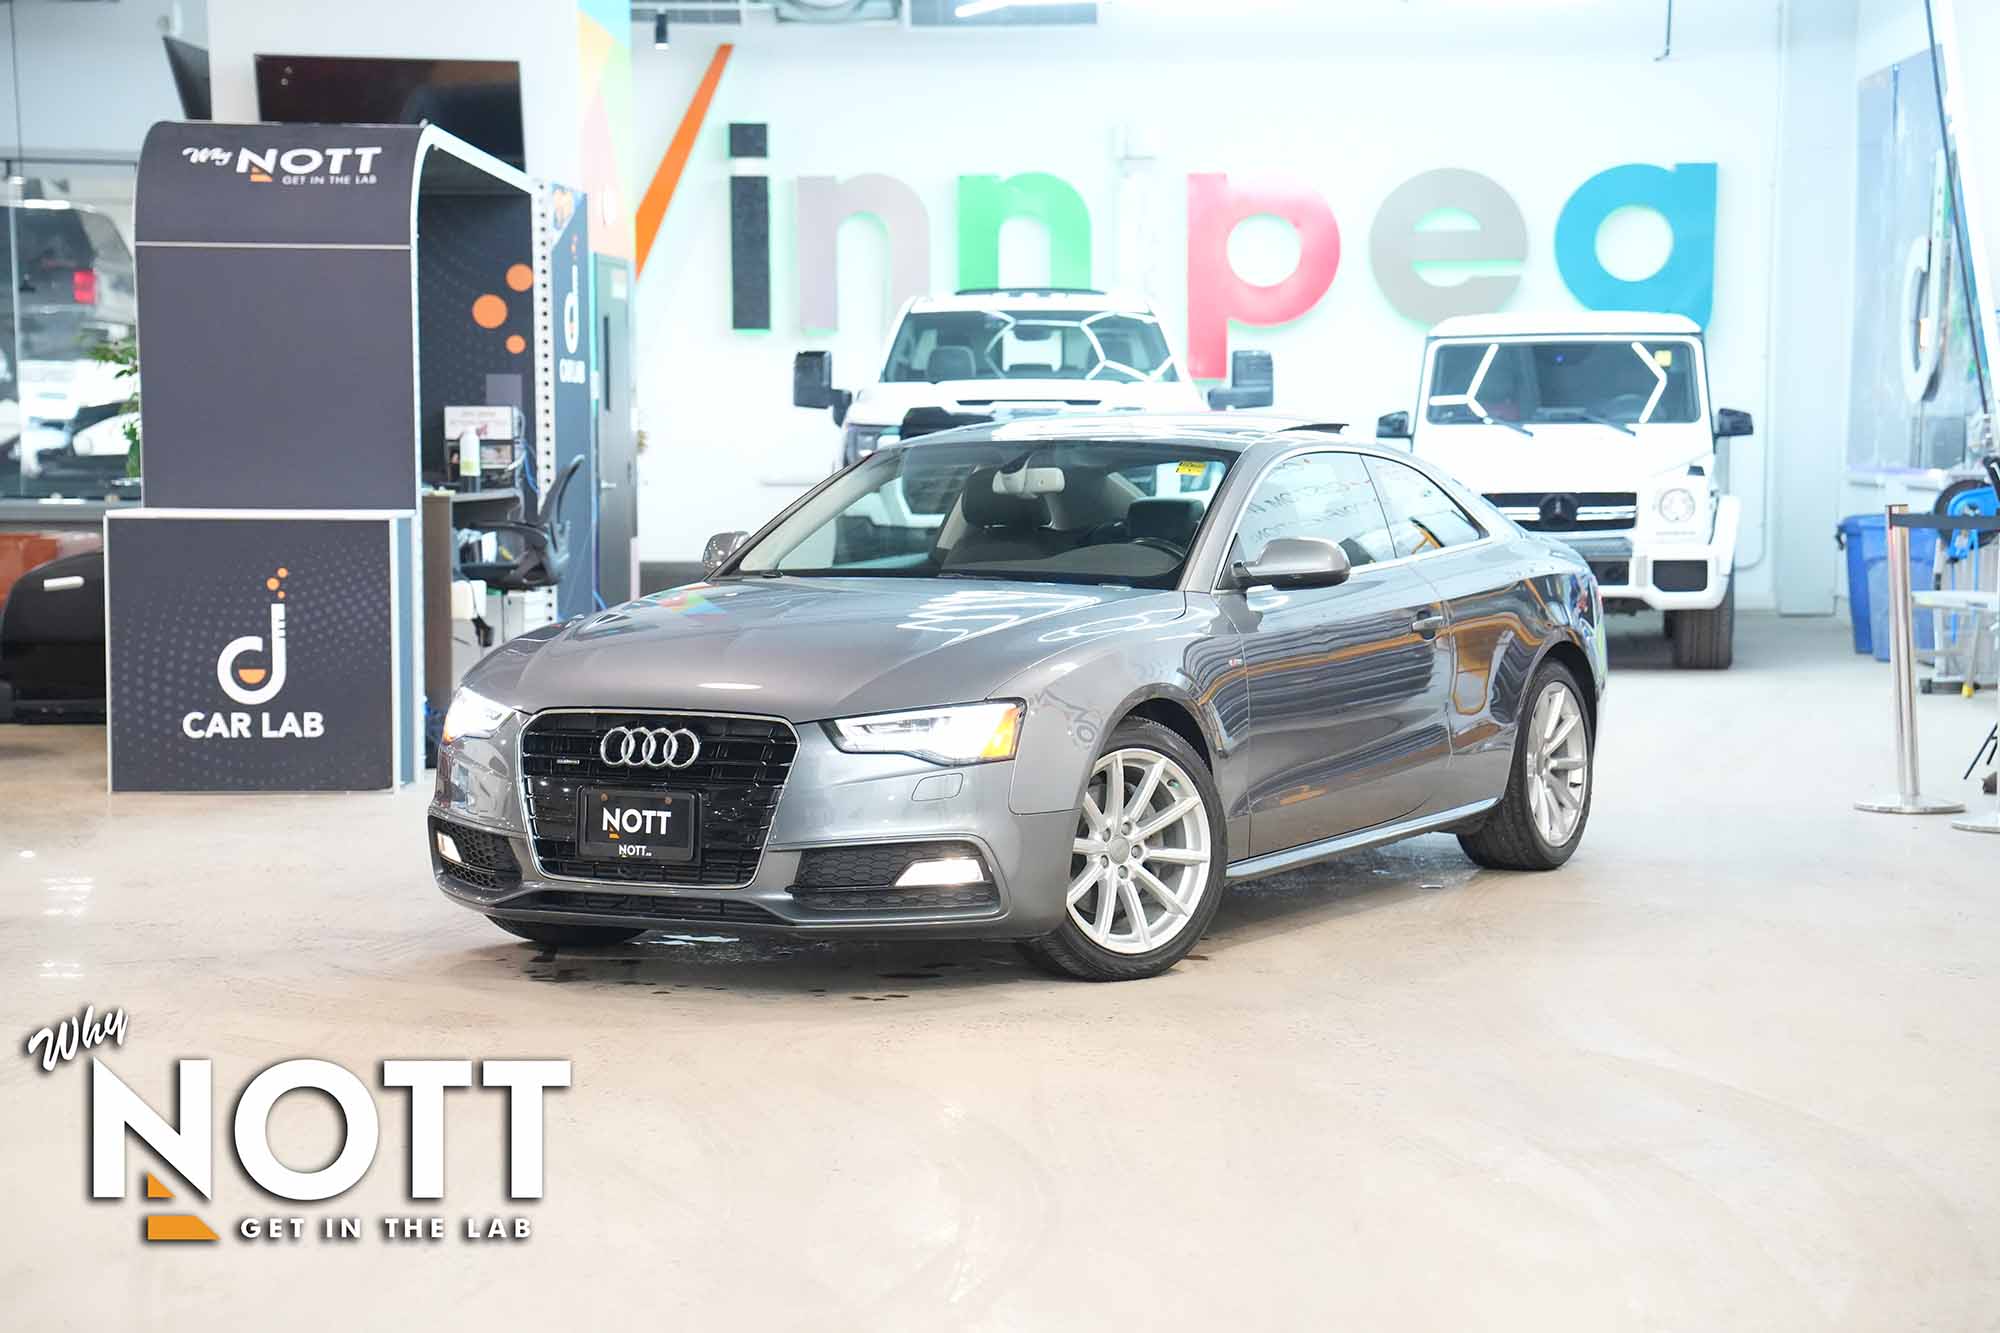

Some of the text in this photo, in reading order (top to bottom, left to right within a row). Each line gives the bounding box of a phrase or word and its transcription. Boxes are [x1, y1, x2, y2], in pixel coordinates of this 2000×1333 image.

[236, 147, 382, 175] NOTT
[282, 175, 377, 185] GET IN THE LAB
[182, 712, 325, 738] CAR LAB
[602, 807, 672, 835] NOTT
